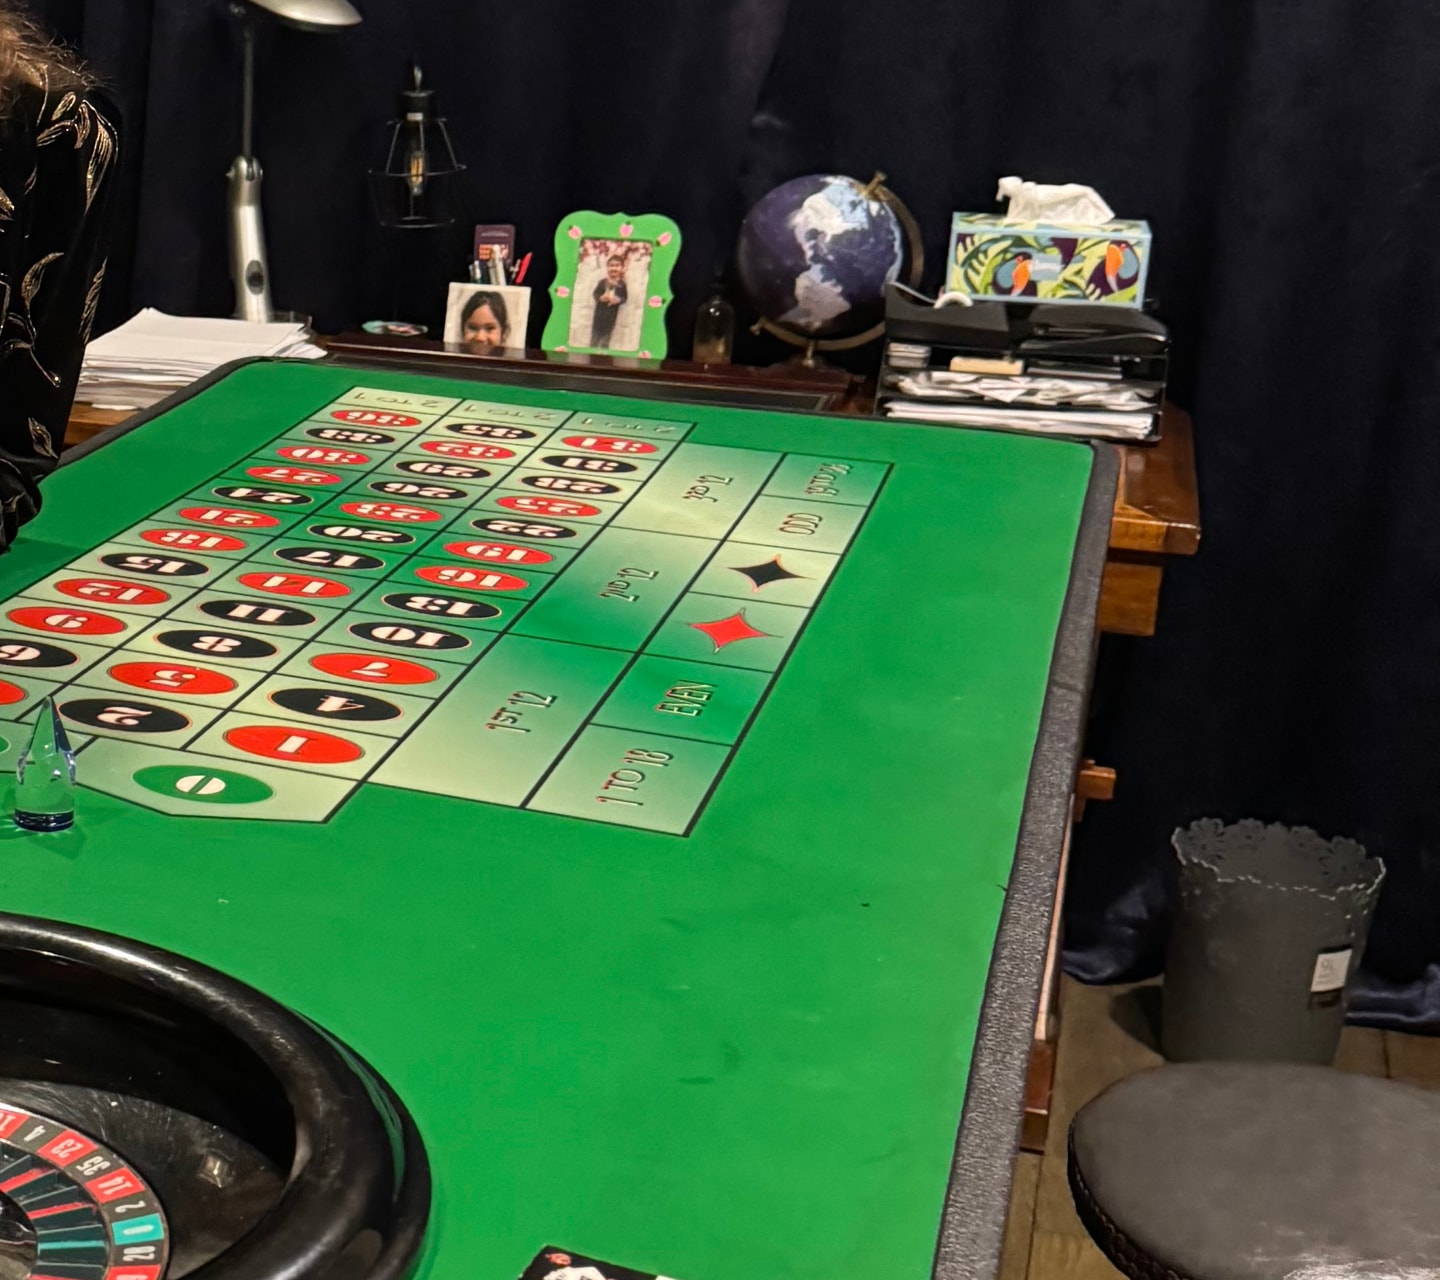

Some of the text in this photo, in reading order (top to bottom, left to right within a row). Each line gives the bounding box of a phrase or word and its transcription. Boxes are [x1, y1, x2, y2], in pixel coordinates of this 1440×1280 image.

[345, 411, 408, 426] 36
[320, 428, 383, 443] 33
[459, 424, 526, 439] 35
[433, 441, 503, 458] 32
[578, 436, 642, 453] 34
[291, 448, 357, 463] 30
[562, 456, 621, 472] 31
[263, 468, 328, 483] 27
[408, 461, 480, 478] 29
[536, 476, 608, 493] 28
[696, 473, 734, 487] 12
[230, 487, 300, 504] 24
[382, 482, 455, 499] 26
[356, 503, 427, 520] 23
[513, 497, 585, 515] 25
[201, 510, 261, 525] 21
[778, 512, 823, 536] ODD
[324, 526, 402, 542] 20
[485, 519, 564, 537] 22
[161, 531, 223, 549] 18
[294, 551, 362, 568] 17
[465, 543, 530, 562] 19
[118, 555, 190, 574] 15
[438, 569, 503, 588] 16
[617, 566, 660, 581] 12
[78, 581, 146, 602] 12
[262, 575, 327, 595] 14
[226, 603, 293, 623] 11
[404, 596, 479, 616] 13
[44, 613, 89, 629] 9
[191, 635, 243, 653] 8
[370, 625, 448, 647] 10
[349, 660, 391, 677] 7
[148, 669, 198, 689] 5
[316, 694, 366, 712] 4
[507, 690, 558, 708] 12
[655, 679, 718, 717] EVEN
[95, 705, 154, 727] 2
[275, 734, 318, 755] 1
[175, 774, 227, 795] 0
[595, 747, 674, 807] 1 TO 18
[23, 1125, 46, 1142] 4
[50, 1138, 85, 1159] 23
[75, 1155, 111, 1176] 35
[97, 1175, 134, 1195] 14
[115, 1200, 146, 1213] 2
[122, 1224, 154, 1236] 0
[122, 1245, 156, 1262] 28
